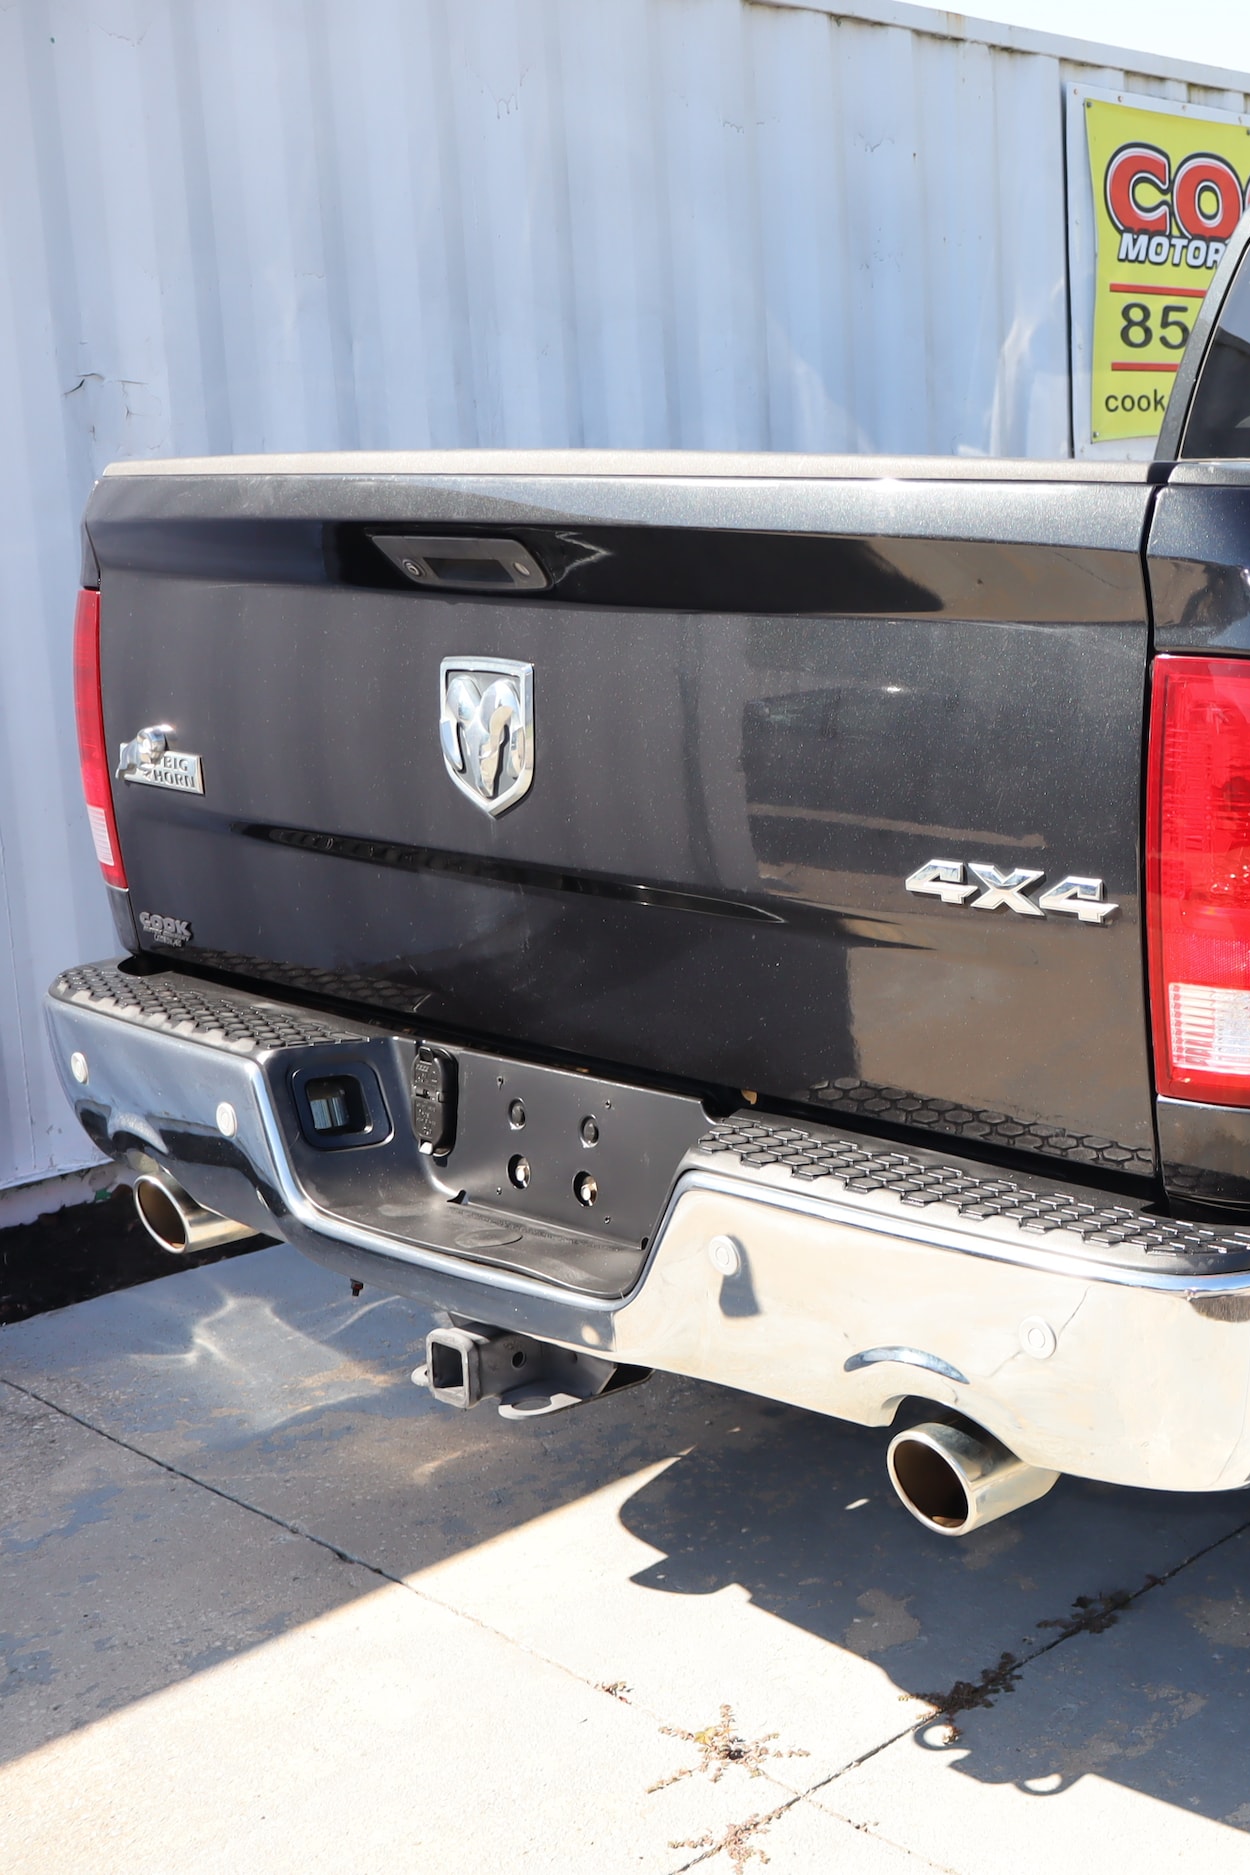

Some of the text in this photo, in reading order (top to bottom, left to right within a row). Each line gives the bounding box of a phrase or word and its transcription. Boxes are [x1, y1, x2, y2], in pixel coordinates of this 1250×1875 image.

[1120, 302, 1190, 350] 85
[1105, 388, 1165, 413] cook
[163, 755, 189, 772] BIG
[153, 769, 195, 788] HORN
[139, 911, 192, 938] COOK
